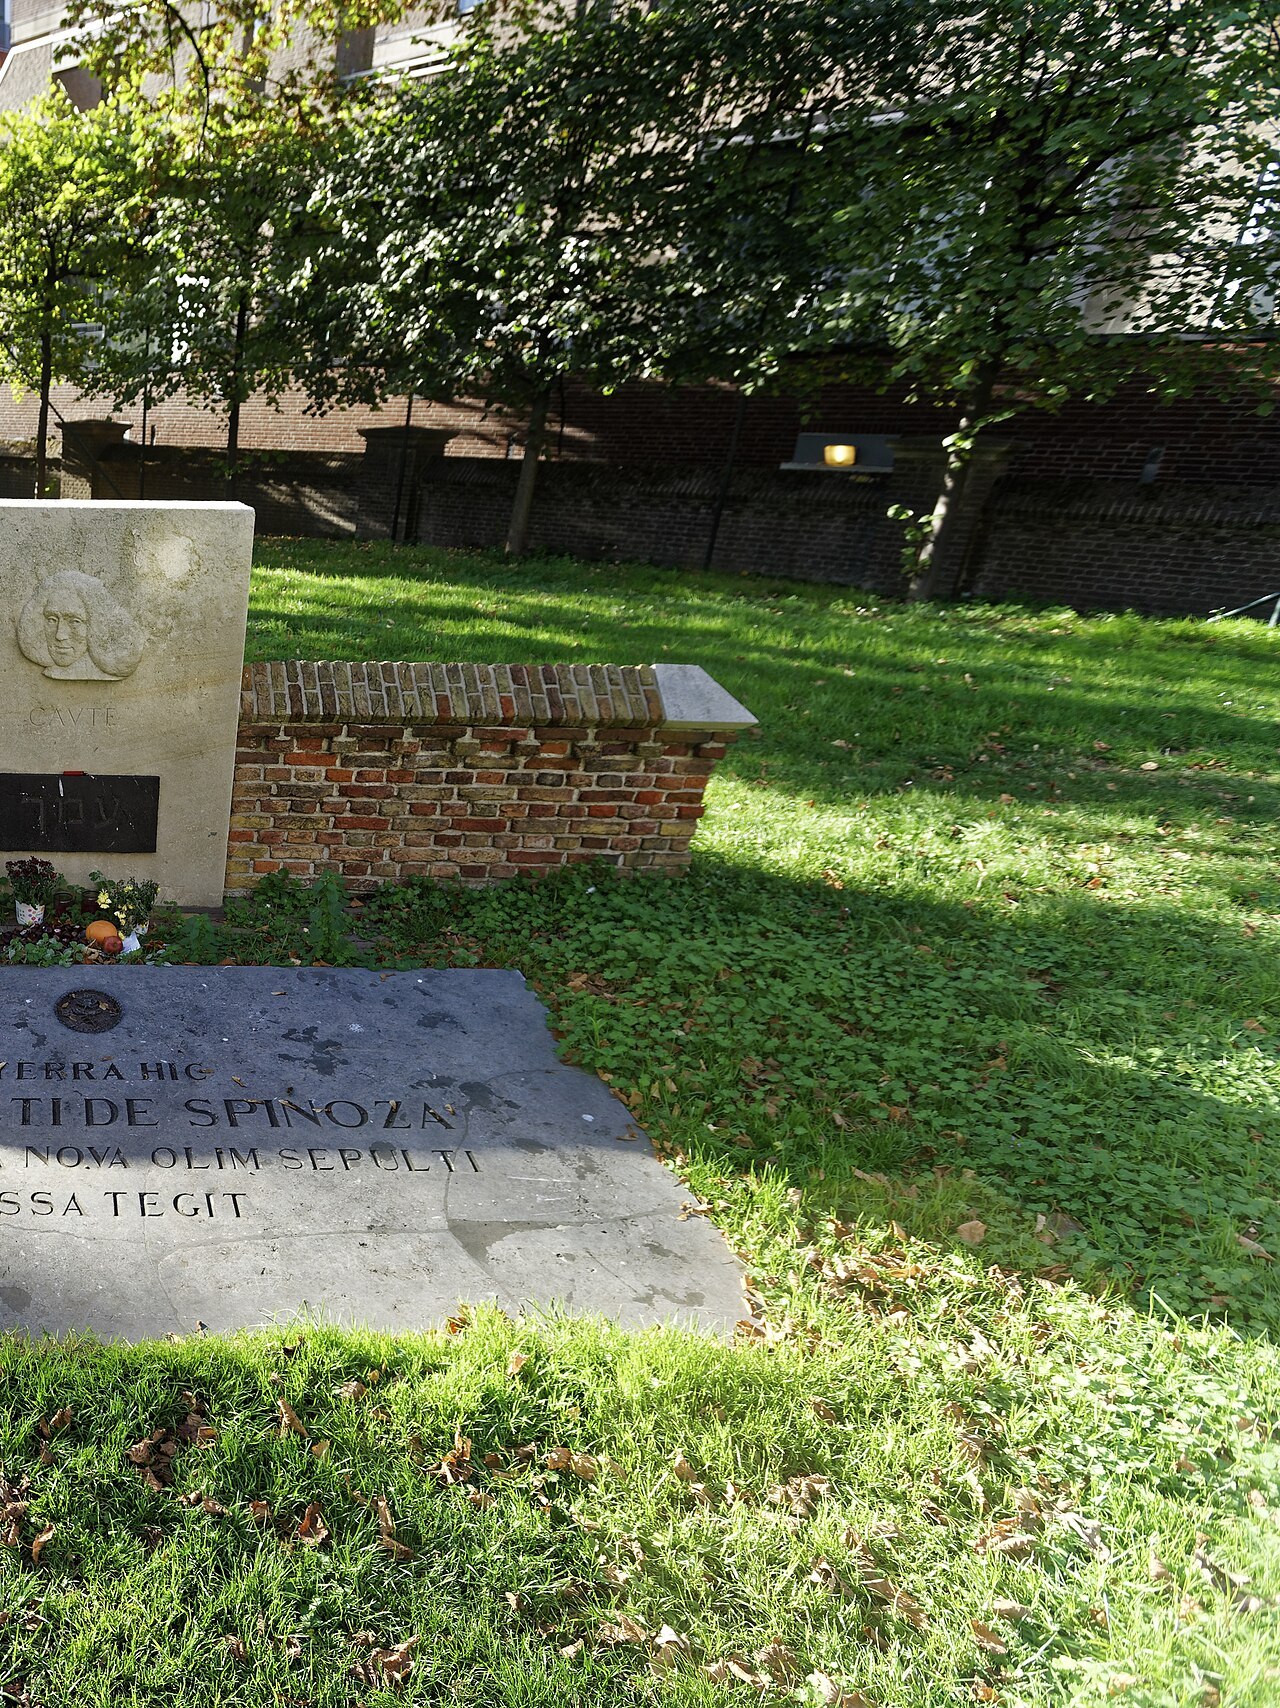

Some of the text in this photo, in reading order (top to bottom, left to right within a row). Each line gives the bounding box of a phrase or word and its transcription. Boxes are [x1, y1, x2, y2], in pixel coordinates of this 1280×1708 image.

[29, 707, 118, 727] CAVTE
[138, 1061, 208, 1081] HIC
[83, 1098, 160, 1127] DE
[184, 1098, 456, 1130] SPINOZA
[24, 1145, 132, 1169] NOVA
[151, 1146, 261, 1170] OLIM
[278, 1147, 482, 1173] SEPULTI
[103, 1191, 247, 1218] TEGIT
